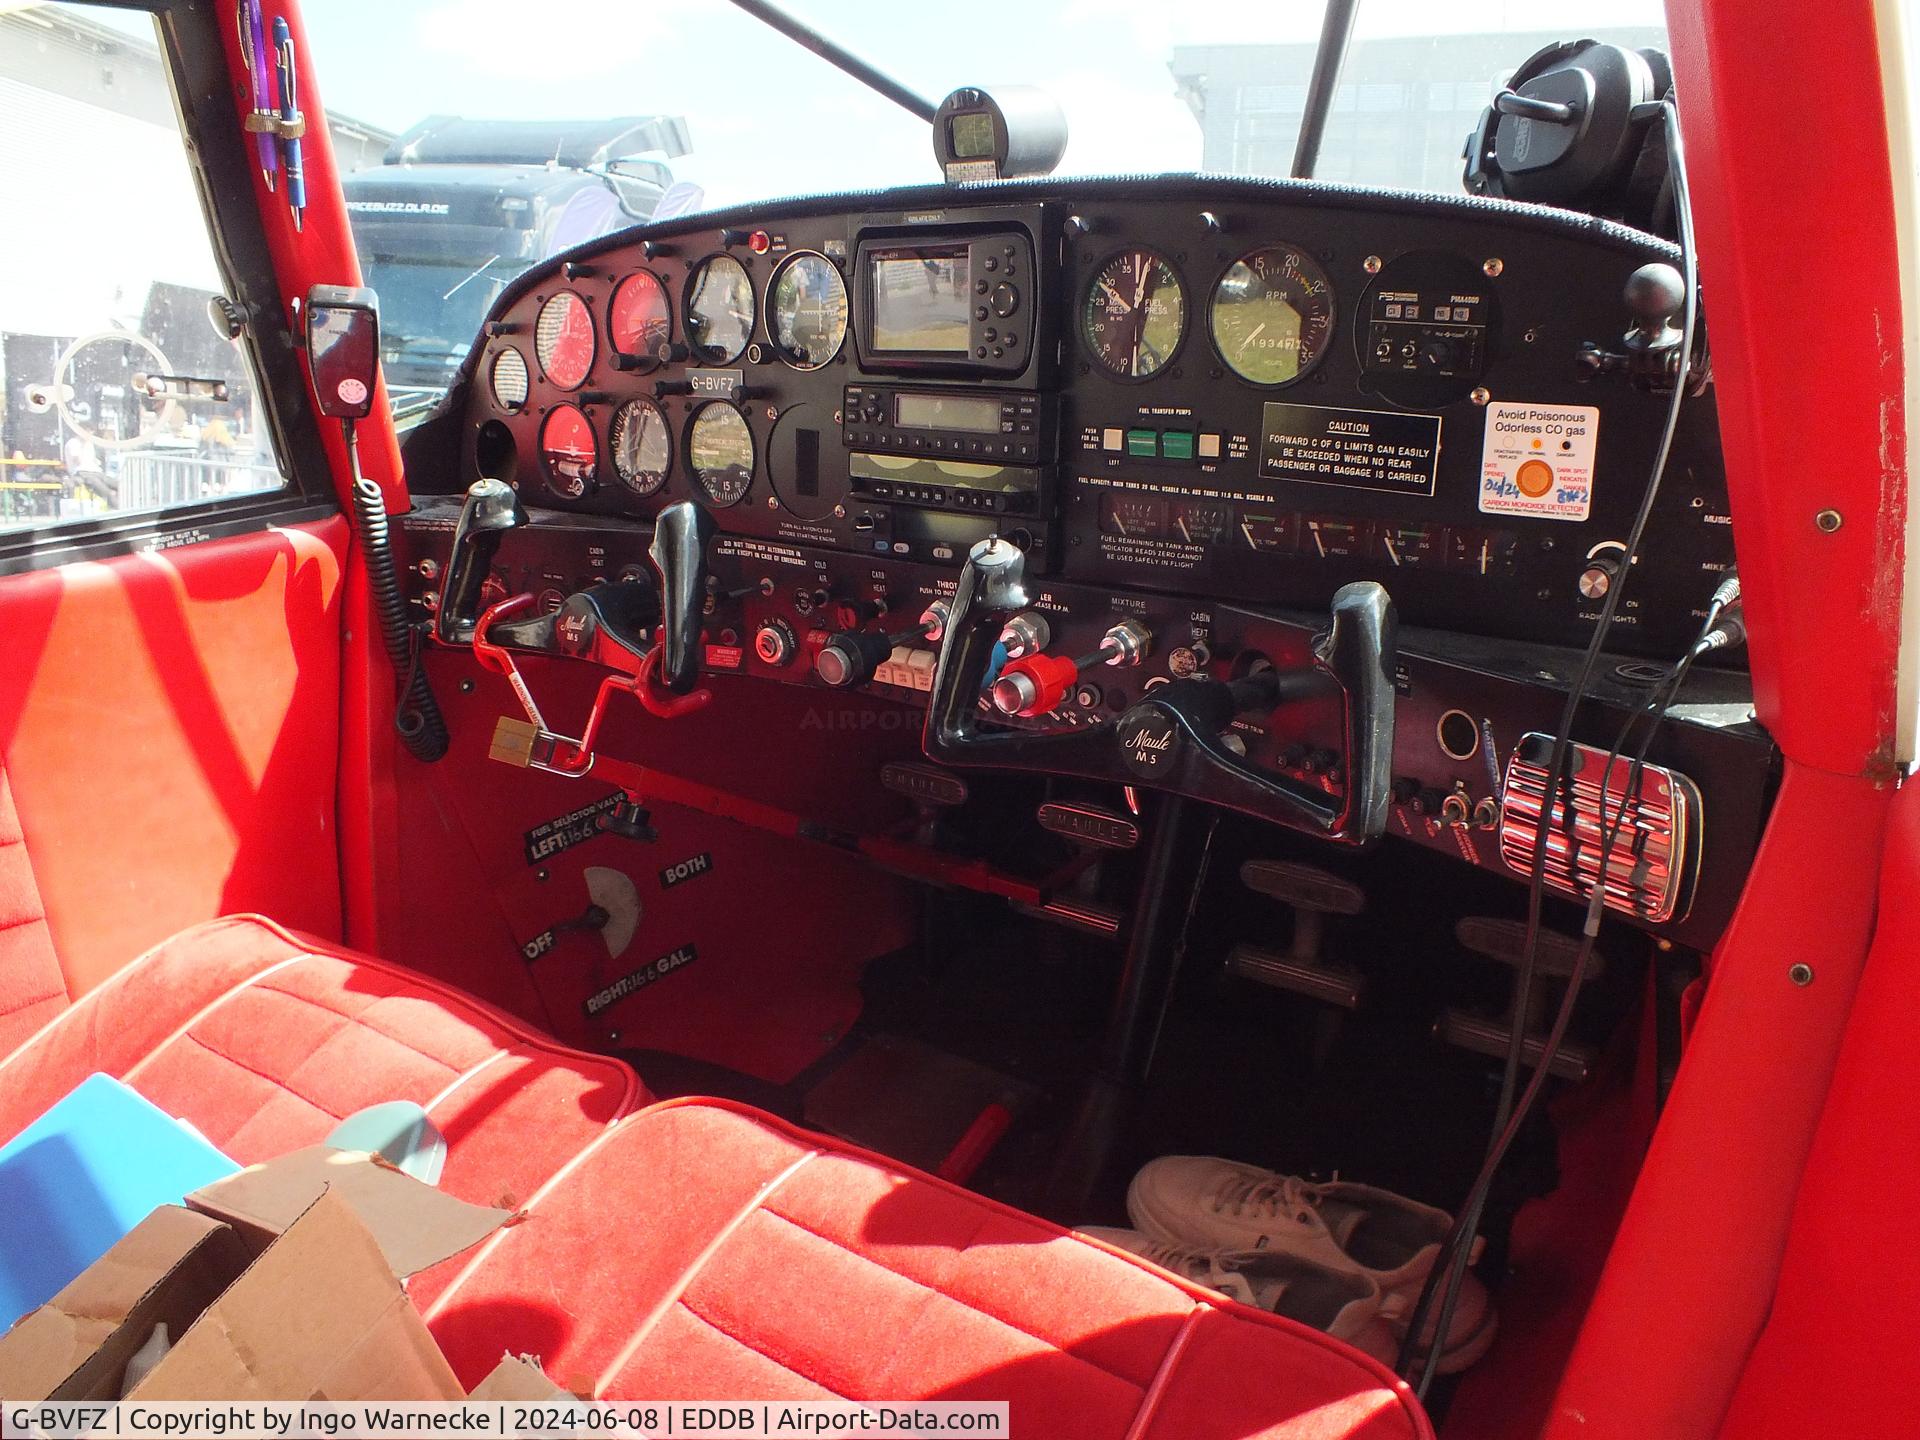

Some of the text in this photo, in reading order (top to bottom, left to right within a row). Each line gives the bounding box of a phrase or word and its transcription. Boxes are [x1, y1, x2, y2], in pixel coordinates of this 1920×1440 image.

[1255, 257, 1265, 269] 15
[1285, 254, 1300, 268] 20
[1122, 265, 1132, 274] 35
[1106, 278, 1116, 287] 30
[1162, 275, 1167, 284] 2
[1266, 291, 1287, 300] RPM
[1096, 298, 1105, 306] 25
[1145, 306, 1168, 315] PRESS
[1094, 323, 1105, 332] 20
[1223, 318, 1230, 330] 5
[1103, 343, 1110, 352] 15
[1120, 358, 1128, 366] 10
[691, 376, 734, 391] G-BVFZ
[1138, 407, 1150, 415] FUEL
[1175, 408, 1192, 416] PUMPS
[1497, 409, 1586, 422] Avoid Poisonous
[1328, 421, 1370, 433] CAUTION
[1495, 422, 1586, 437] Odorless CO gas
[1232, 435, 1246, 443] PUSH
[1227, 442, 1250, 451] FOR AUX.
[1269, 434, 1430, 459] FORWARD C OF G LIMITS CAN EASILY
[1230, 450, 1247, 459] QUANT.
[1283, 448, 1412, 469] BE EXCEEDED WHEN NO REAR
[1201, 465, 1217, 473] RIGHT
[1267, 458, 1426, 484] PASSENGER OR BAGGAGE IS CARRIED
[723, 481, 731, 491] 15
[1078, 476, 1088, 484] FUEL
[1112, 480, 1124, 488] MAIN
[1125, 481, 1140, 490] TANKS
[1150, 484, 1160, 492] GAL.
[1162, 485, 1179, 494] USABLE
[1192, 488, 1201, 496] AUX
[1203, 489, 1219, 498] TANKS
[1233, 492, 1245, 500] GAL.
[1246, 493, 1265, 502] USABLE
[1483, 499, 1584, 512] CARBON MONOXIDE DETECTOR
[1703, 515, 1732, 525] MUSIC
[802, 525, 823, 534] AVIONICS
[796, 531, 818, 540] STARTING
[819, 535, 836, 543] ENGINE
[745, 542, 757, 550] TURN
[767, 546, 795, 556] ALTERNATOR
[1101, 534, 1204, 553] FUEL REMAINING IN TANK WHEN
[717, 547, 735, 555] FLIGHT
[737, 548, 753, 558] EXCEPT
[761, 553, 773, 561] CASE
[780, 556, 807, 566] EMERGENCY
[1101, 544, 1203, 561] INDICATOR READS ZERO CANNOT
[814, 561, 827, 569] COLD
[1116, 554, 1133, 562] USED
[1135, 555, 1159, 566] SAFELY
[1161, 559, 1169, 567] IN
[1170, 560, 1194, 569] FLIGHT
[1702, 562, 1726, 572] MIKE
[818, 574, 828, 582] AIR
[871, 571, 885, 579] CARB
[872, 584, 886, 593] HEAT
[1111, 597, 1146, 609] MIXTURE
[1190, 612, 1211, 623] CABIN
[1612, 616, 1637, 624] IGHTS
[1125, 728, 1172, 751] Maule
[1136, 751, 1146, 762] M
[531, 792, 624, 838] FUEL SELECTOR VALVE
[1058, 814, 1120, 839] MAULE
[665, 855, 707, 884] BOTH
[525, 931, 553, 959] OFF
[656, 950, 692, 973] GAL.
